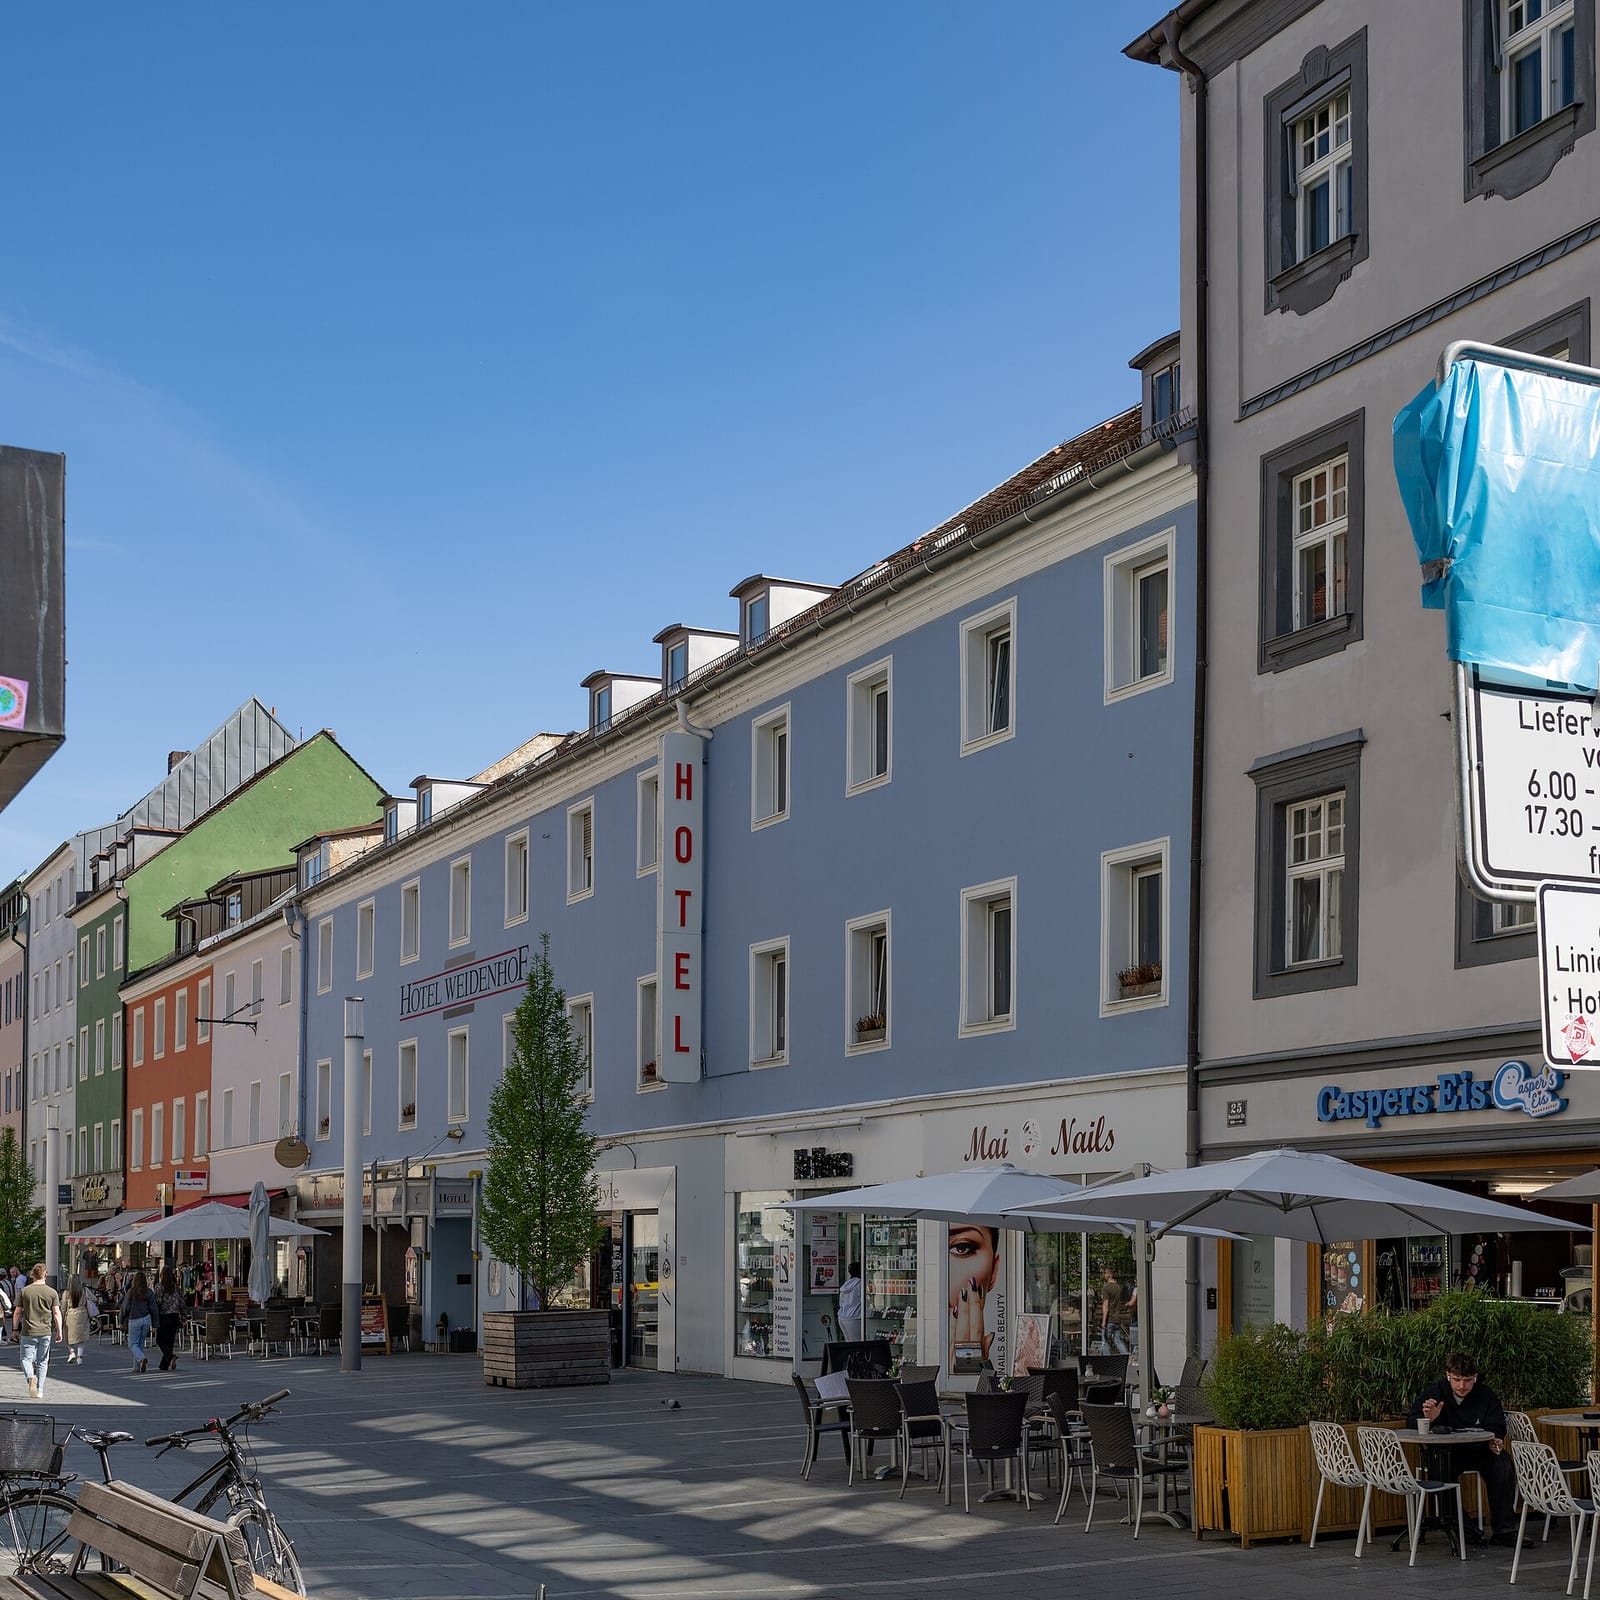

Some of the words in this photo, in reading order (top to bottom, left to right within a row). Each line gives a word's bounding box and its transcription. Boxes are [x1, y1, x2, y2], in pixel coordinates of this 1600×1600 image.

[1582, 747, 1600, 769] v
[1527, 768, 1577, 801] 6.00
[1524, 804, 1584, 838] 17.30
[1588, 845, 1600, 875] f
[674, 762, 692, 1053] HOTEL
[1555, 945, 1600, 974] Lini
[400, 982, 442, 1016] HOTEL
[443, 944, 530, 1002] WEIDENHOF
[1567, 987, 1600, 1015] Ho
[1230, 1103, 1242, 1113] 25
[1317, 1085, 1436, 1128] Caspers
[1437, 1070, 1491, 1112] Eis
[963, 1125, 1009, 1162] Mai
[1050, 1115, 1115, 1156] Nails
[439, 1193, 470, 1203] HOTEL
[997, 1293, 1005, 1333] BEAUTY
[997, 1345, 1006, 1376] NAILS
